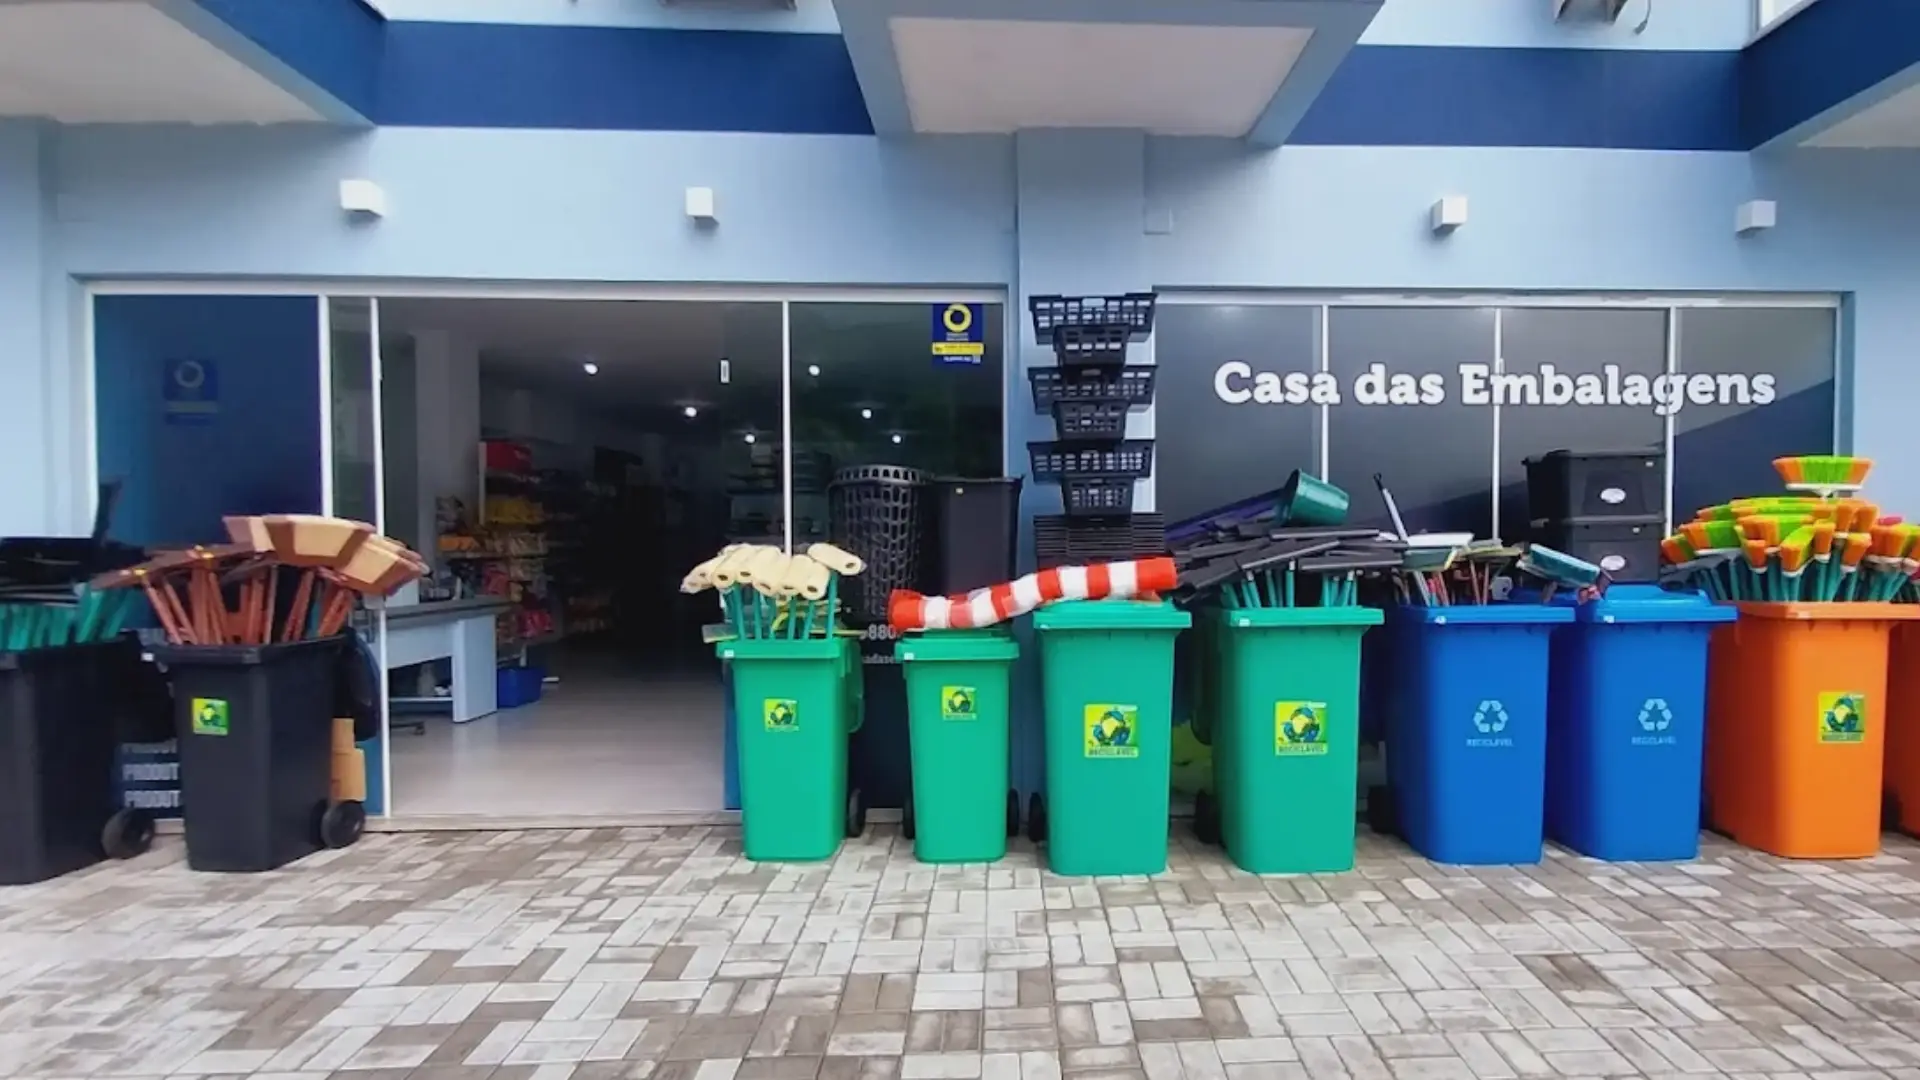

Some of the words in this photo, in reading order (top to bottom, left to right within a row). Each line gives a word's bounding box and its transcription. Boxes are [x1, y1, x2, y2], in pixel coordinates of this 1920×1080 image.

[1214, 361, 1340, 405] Casa
[1354, 363, 1445, 405] das
[1458, 364, 1776, 415] Embalagens
